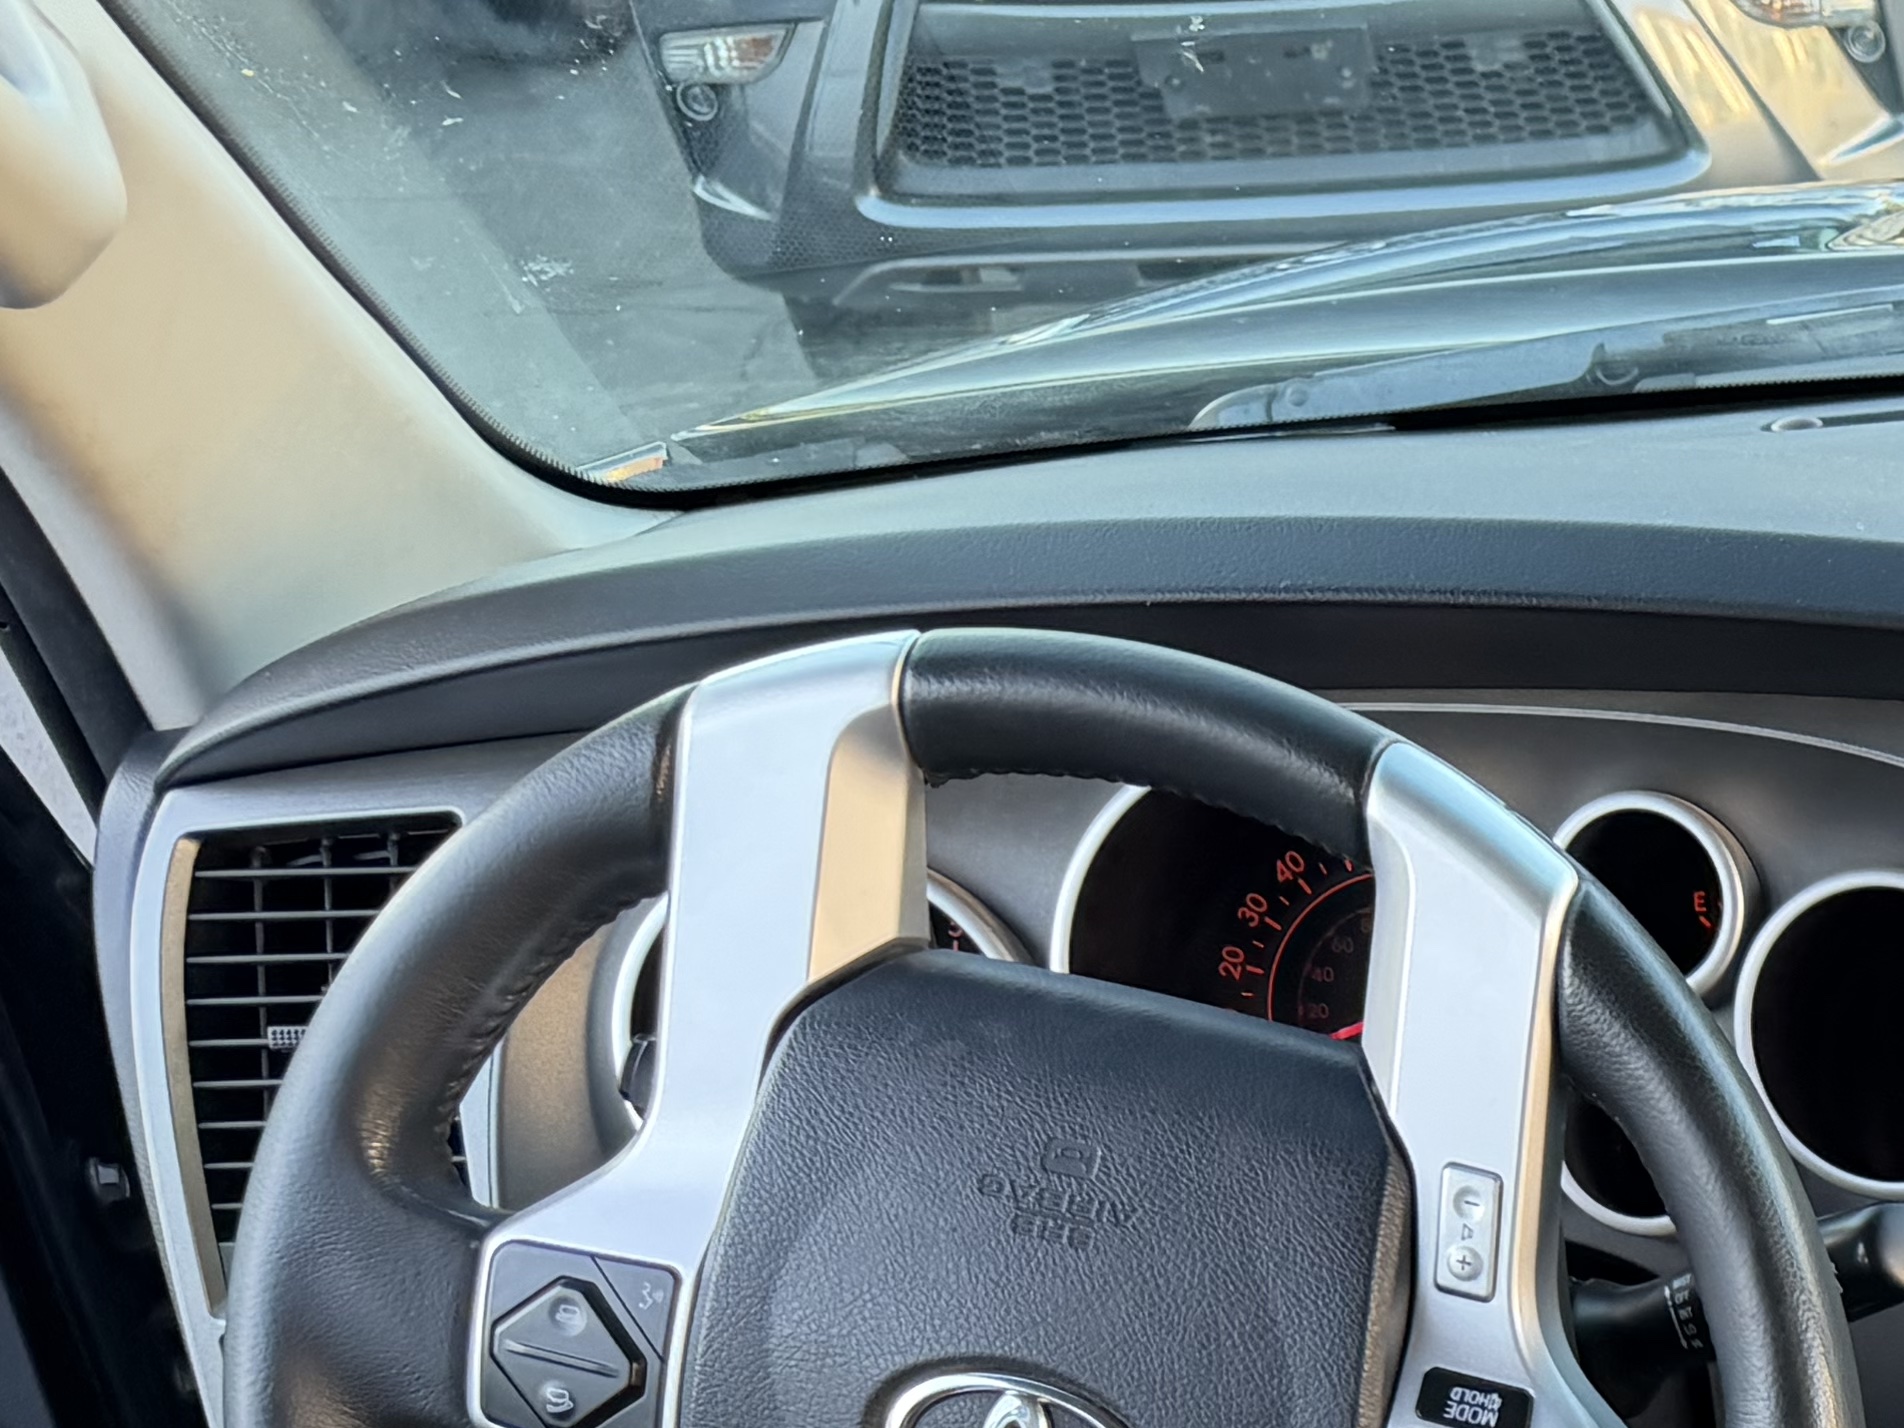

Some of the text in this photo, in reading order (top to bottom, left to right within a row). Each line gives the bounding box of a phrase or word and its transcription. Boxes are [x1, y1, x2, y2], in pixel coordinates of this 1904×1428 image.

[1276, 850, 1305, 884] 40
[1237, 892, 1268, 928] 30
[1693, 891, 1707, 912] E
[1218, 945, 1245, 981] 20
[1449, 1386, 1490, 1408] HOLD
[1442, 1400, 1500, 1428] MODE
